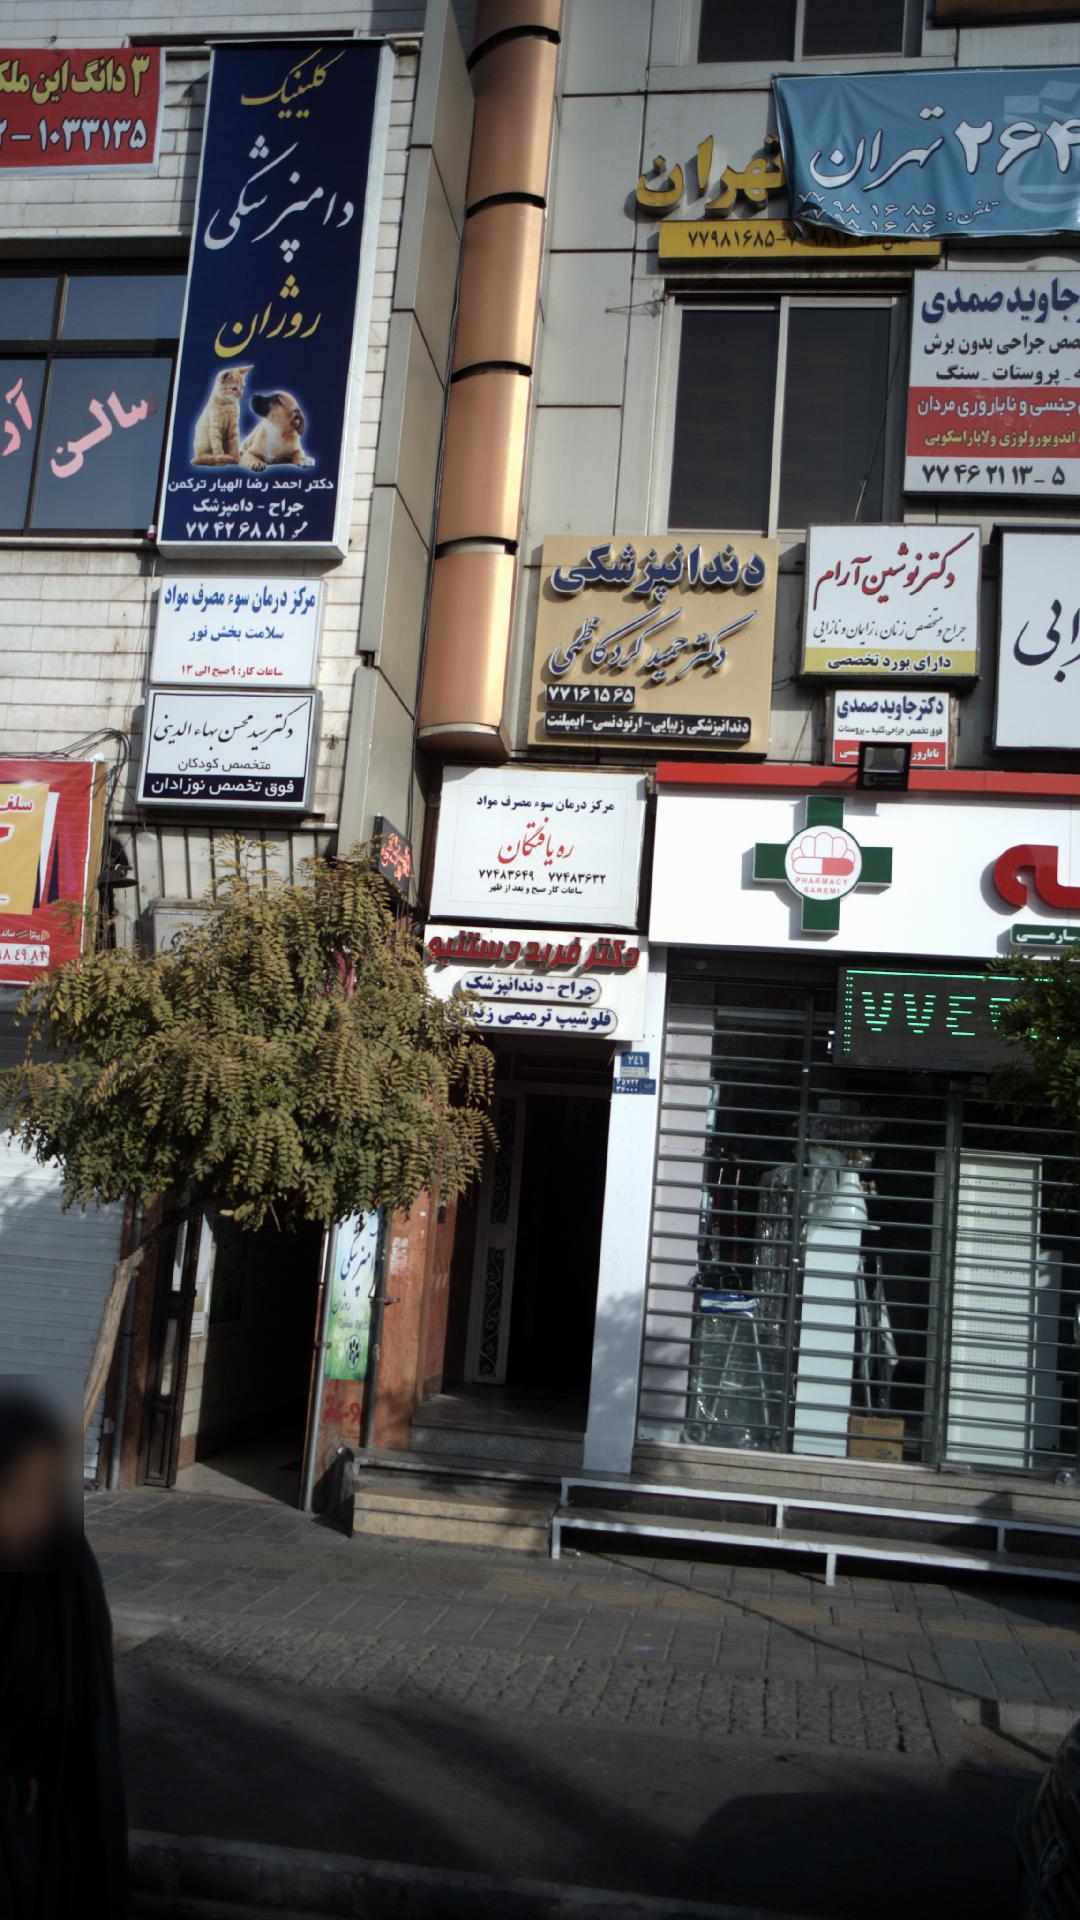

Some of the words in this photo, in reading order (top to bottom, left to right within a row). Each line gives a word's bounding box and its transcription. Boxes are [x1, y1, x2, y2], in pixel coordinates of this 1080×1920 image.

[31, 58, 69, 105] این
[71, 50, 126, 93] دانگ
[131, 54, 150, 96] ۳
[240, 48, 346, 119] کلینیک
[809, 105, 945, 192] تهران
[203, 135, 355, 263] دامپزشکی
[921, 286, 1004, 324] صمدی
[214, 275, 321, 359] روژان
[924, 333, 955, 355] برش
[958, 336, 993, 355] بدون
[996, 332, 1045, 356] جراحی
[936, 364, 980, 381] سنگ
[992, 365, 1060, 385] پروستات
[917, 395, 955, 417] مردان
[1030, 397, 1076, 417] جنسی
[168, 478, 207, 492] ترکمن
[246, 478, 269, 492] رضا
[272, 479, 302, 489] احمد
[305, 478, 335, 492] دکتر
[192, 498, 254, 517] دامپزشک
[268, 498, 304, 517] جراح
[551, 543, 767, 601] دندانپزشکی
[812, 555, 872, 611] آرام
[164, 583, 189, 612] مواد
[192, 582, 225, 613] مصرف
[228, 592, 249, 613] سوء
[252, 584, 288, 614] درمان
[289, 586, 316, 615] مرکز
[188, 625, 208, 642] نور
[210, 625, 241, 642] بخش
[245, 626, 284, 640] سلامت
[676, 609, 758, 677] دکتر
[645, 637, 689, 681] حمید
[828, 654, 879, 670] تخصصی
[882, 656, 910, 671] بورد
[913, 655, 952, 672] دارای
[256, 667, 283, 677] ساعات
[837, 698, 879, 719] صمدی
[880, 695, 917, 720] جاوید
[915, 696, 945, 720] دکتر
[178, 758, 219, 772] کودکان
[221, 760, 271, 773] متخصص
[151, 777, 206, 794] نوزادان
[209, 779, 262, 795] تخصص
[264, 779, 294, 797] فوق
[476, 795, 498, 810] مواد
[501, 795, 531, 811] مصرف
[534, 800, 553, 811] سوء
[555, 798, 587, 813] درمان
[589, 800, 615, 814] مرکز
[561, 886, 583, 894] ساعات
[795, 877, 848, 886] PHARMACY
[523, 937, 582, 971] فرید
[582, 936, 640, 969] دکتر
[465, 975, 544, 996] دندانپزشک
[558, 981, 596, 1000] جراح
[556, 1008, 612, 1031] فلوشیپ
